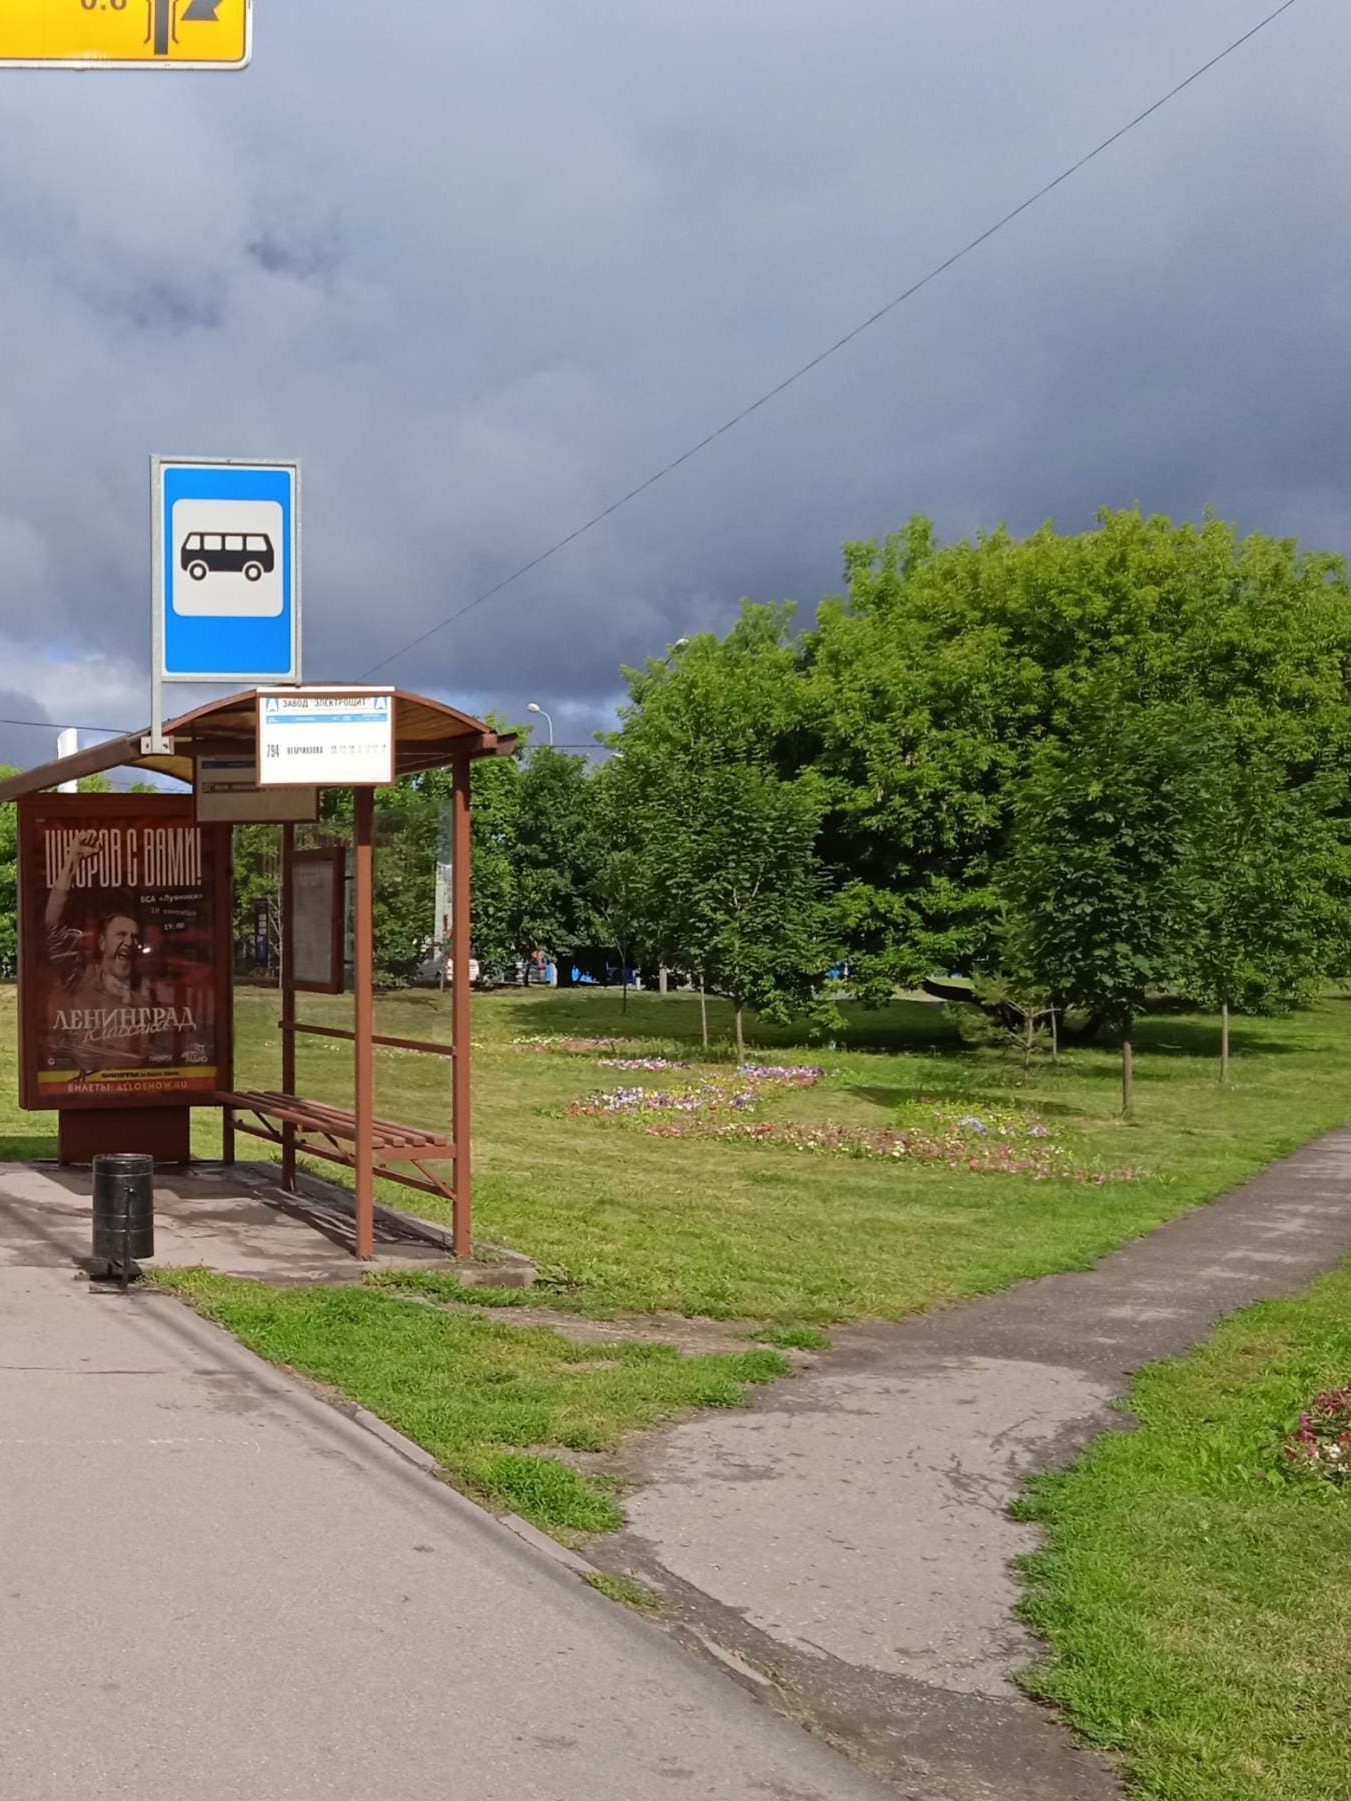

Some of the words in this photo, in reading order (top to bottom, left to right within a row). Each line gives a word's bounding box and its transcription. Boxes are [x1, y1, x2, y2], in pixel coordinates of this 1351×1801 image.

[282, 698, 309, 708] ЗАВОД
[127, 828, 138, 888] С
[143, 827, 202, 887] ВАМИ!
[52, 1006, 197, 1032] ЛЕНИНГРАД
